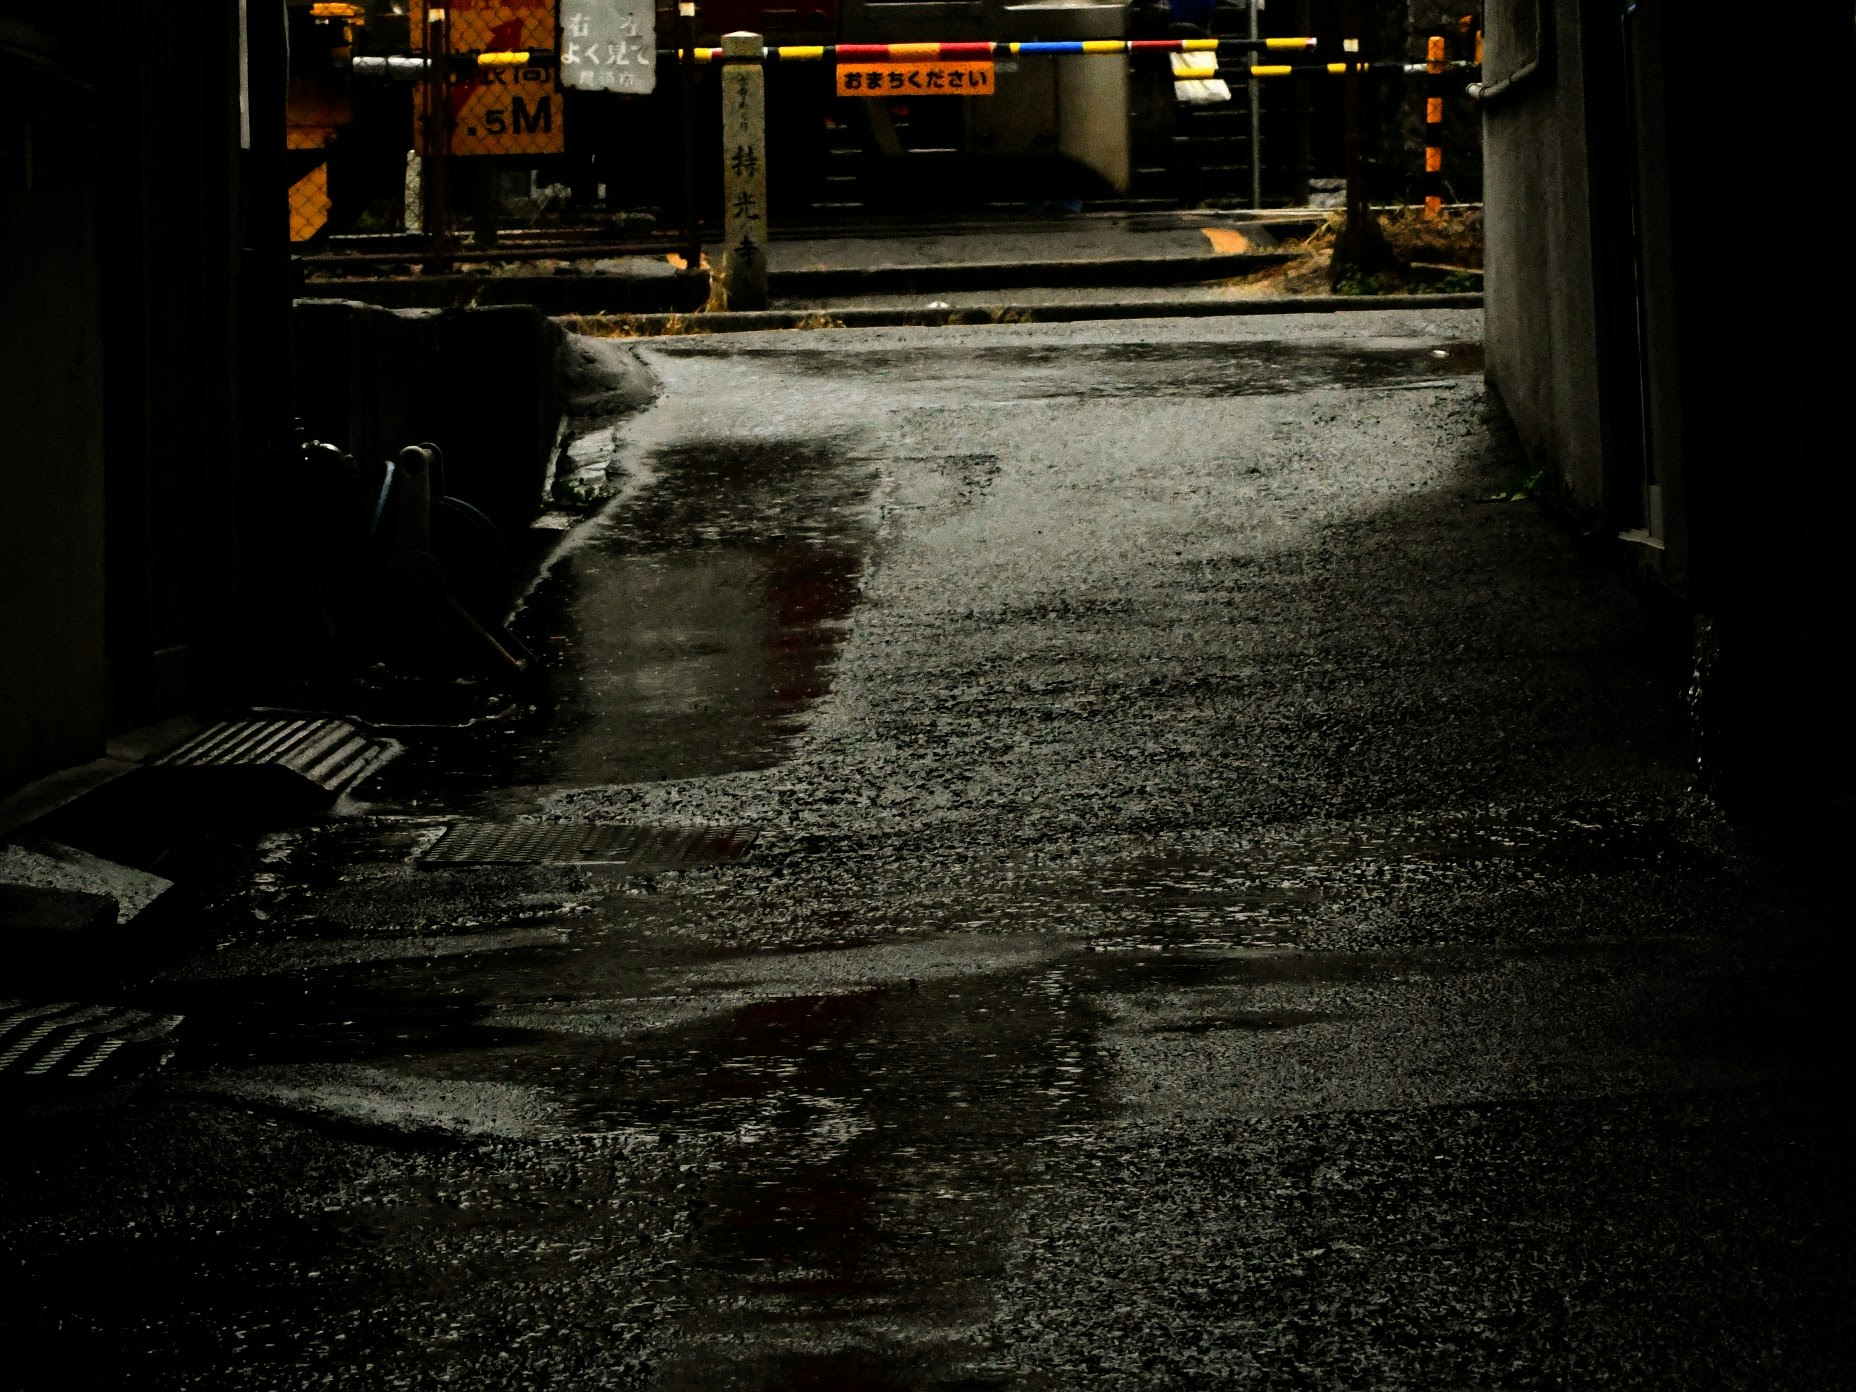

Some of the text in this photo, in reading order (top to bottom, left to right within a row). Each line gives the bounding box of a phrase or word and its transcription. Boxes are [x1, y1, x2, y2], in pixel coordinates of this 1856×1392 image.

[844, 69, 988, 91] おまちください
